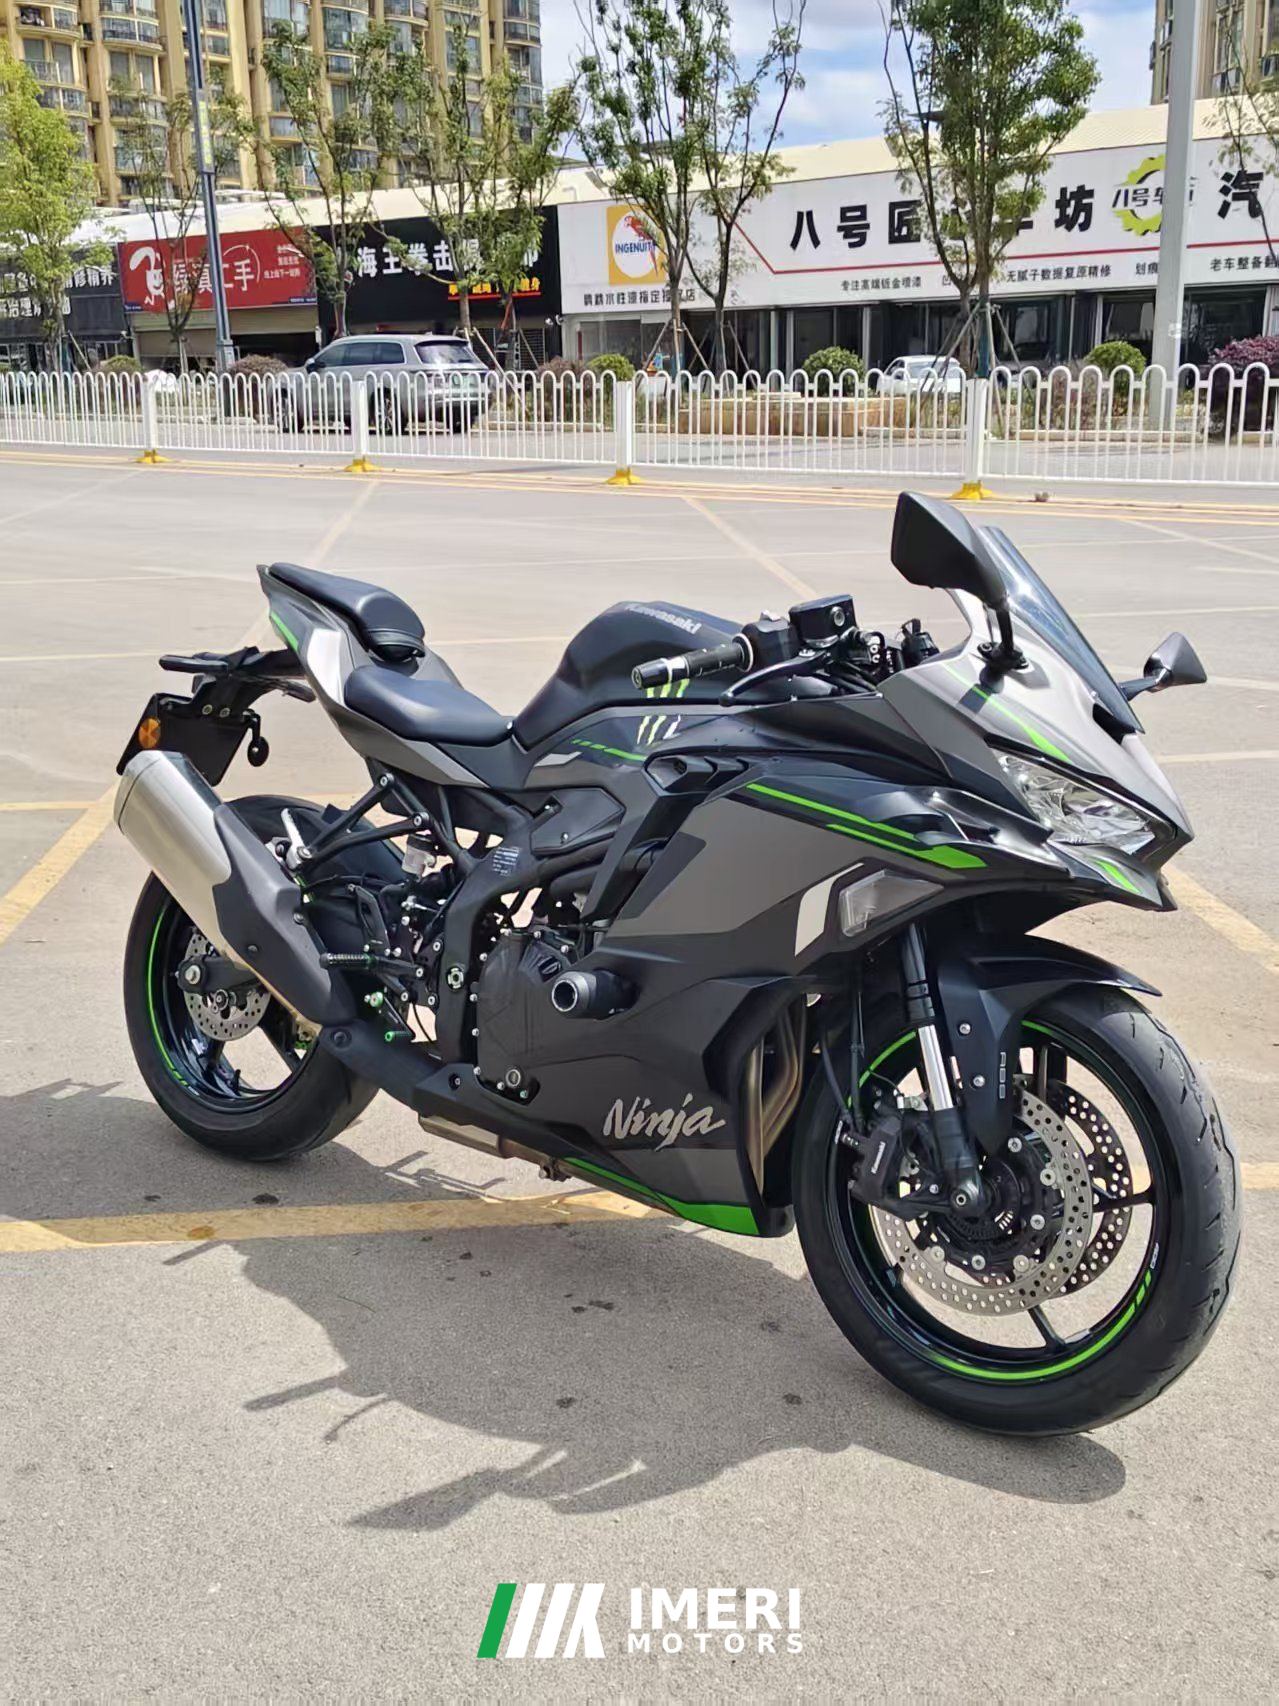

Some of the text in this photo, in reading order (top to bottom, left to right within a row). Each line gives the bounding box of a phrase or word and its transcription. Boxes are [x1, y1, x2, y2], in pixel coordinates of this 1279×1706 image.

[790, 184, 1096, 251] 八号匠坊
[624, 603, 702, 635] Kawasaki
[602, 1092, 726, 1152] Ninja
